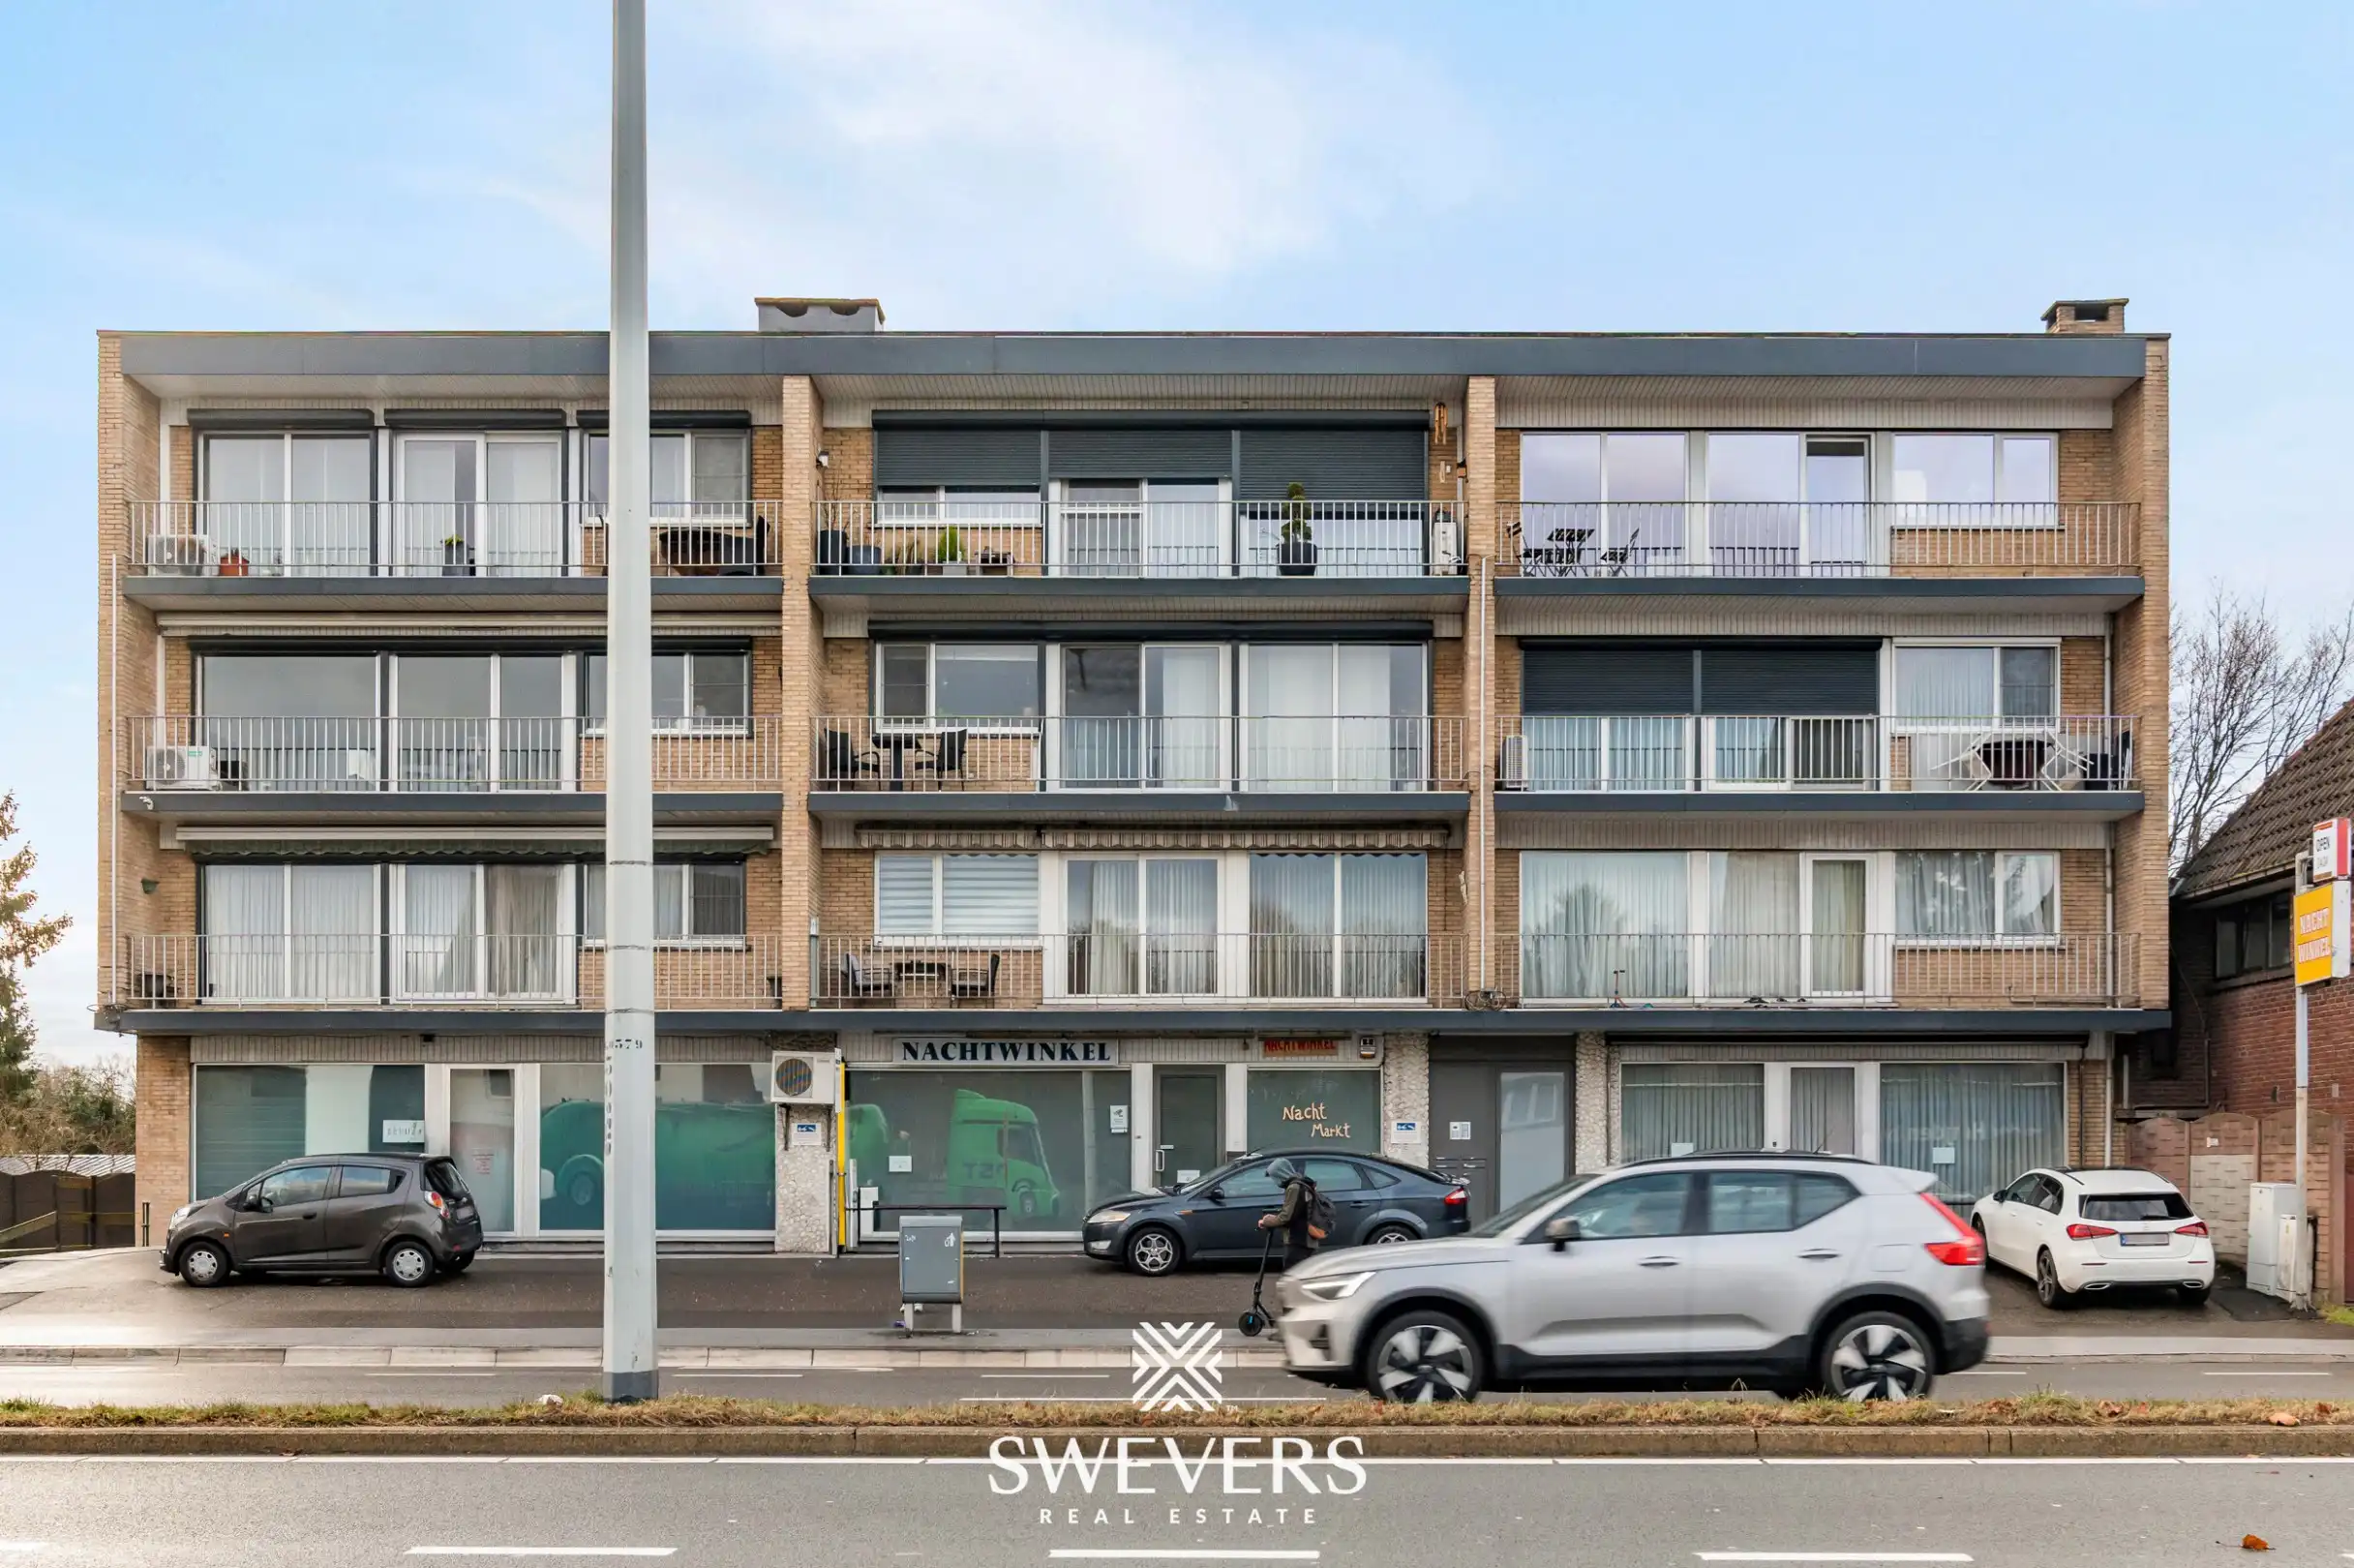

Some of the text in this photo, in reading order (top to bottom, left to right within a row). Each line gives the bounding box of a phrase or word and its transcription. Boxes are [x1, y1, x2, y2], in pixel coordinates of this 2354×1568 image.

[2300, 907, 2330, 934] NACHT
[901, 1041, 1111, 1062] NACHTWINKEL
[1283, 1102, 1327, 1121] Nacht
[1311, 1123, 1351, 1138] Markt
